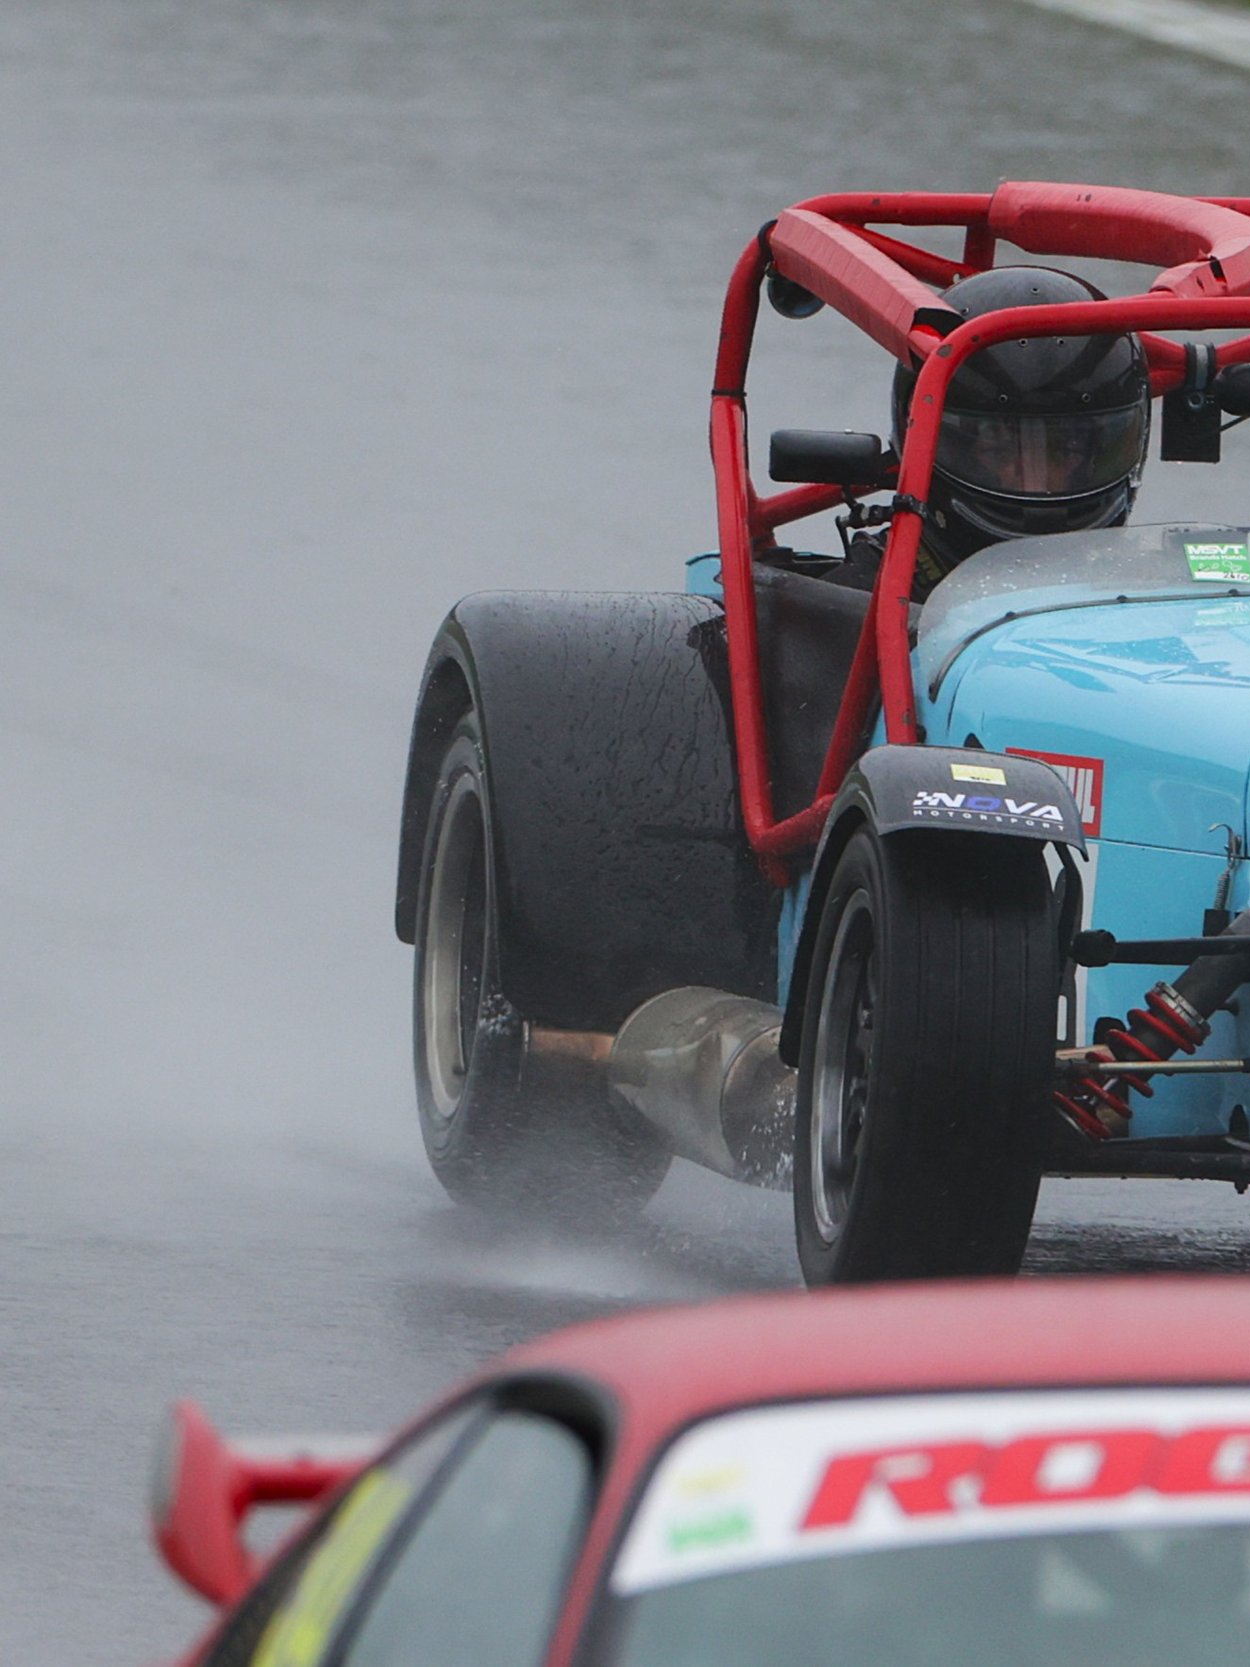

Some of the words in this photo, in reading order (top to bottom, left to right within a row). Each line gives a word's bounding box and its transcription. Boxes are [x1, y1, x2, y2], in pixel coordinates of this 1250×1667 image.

[1186, 544, 1244, 555] MSVT
[926, 792, 1064, 822] NOVA
[912, 810, 1065, 832] MOTORSPORT
